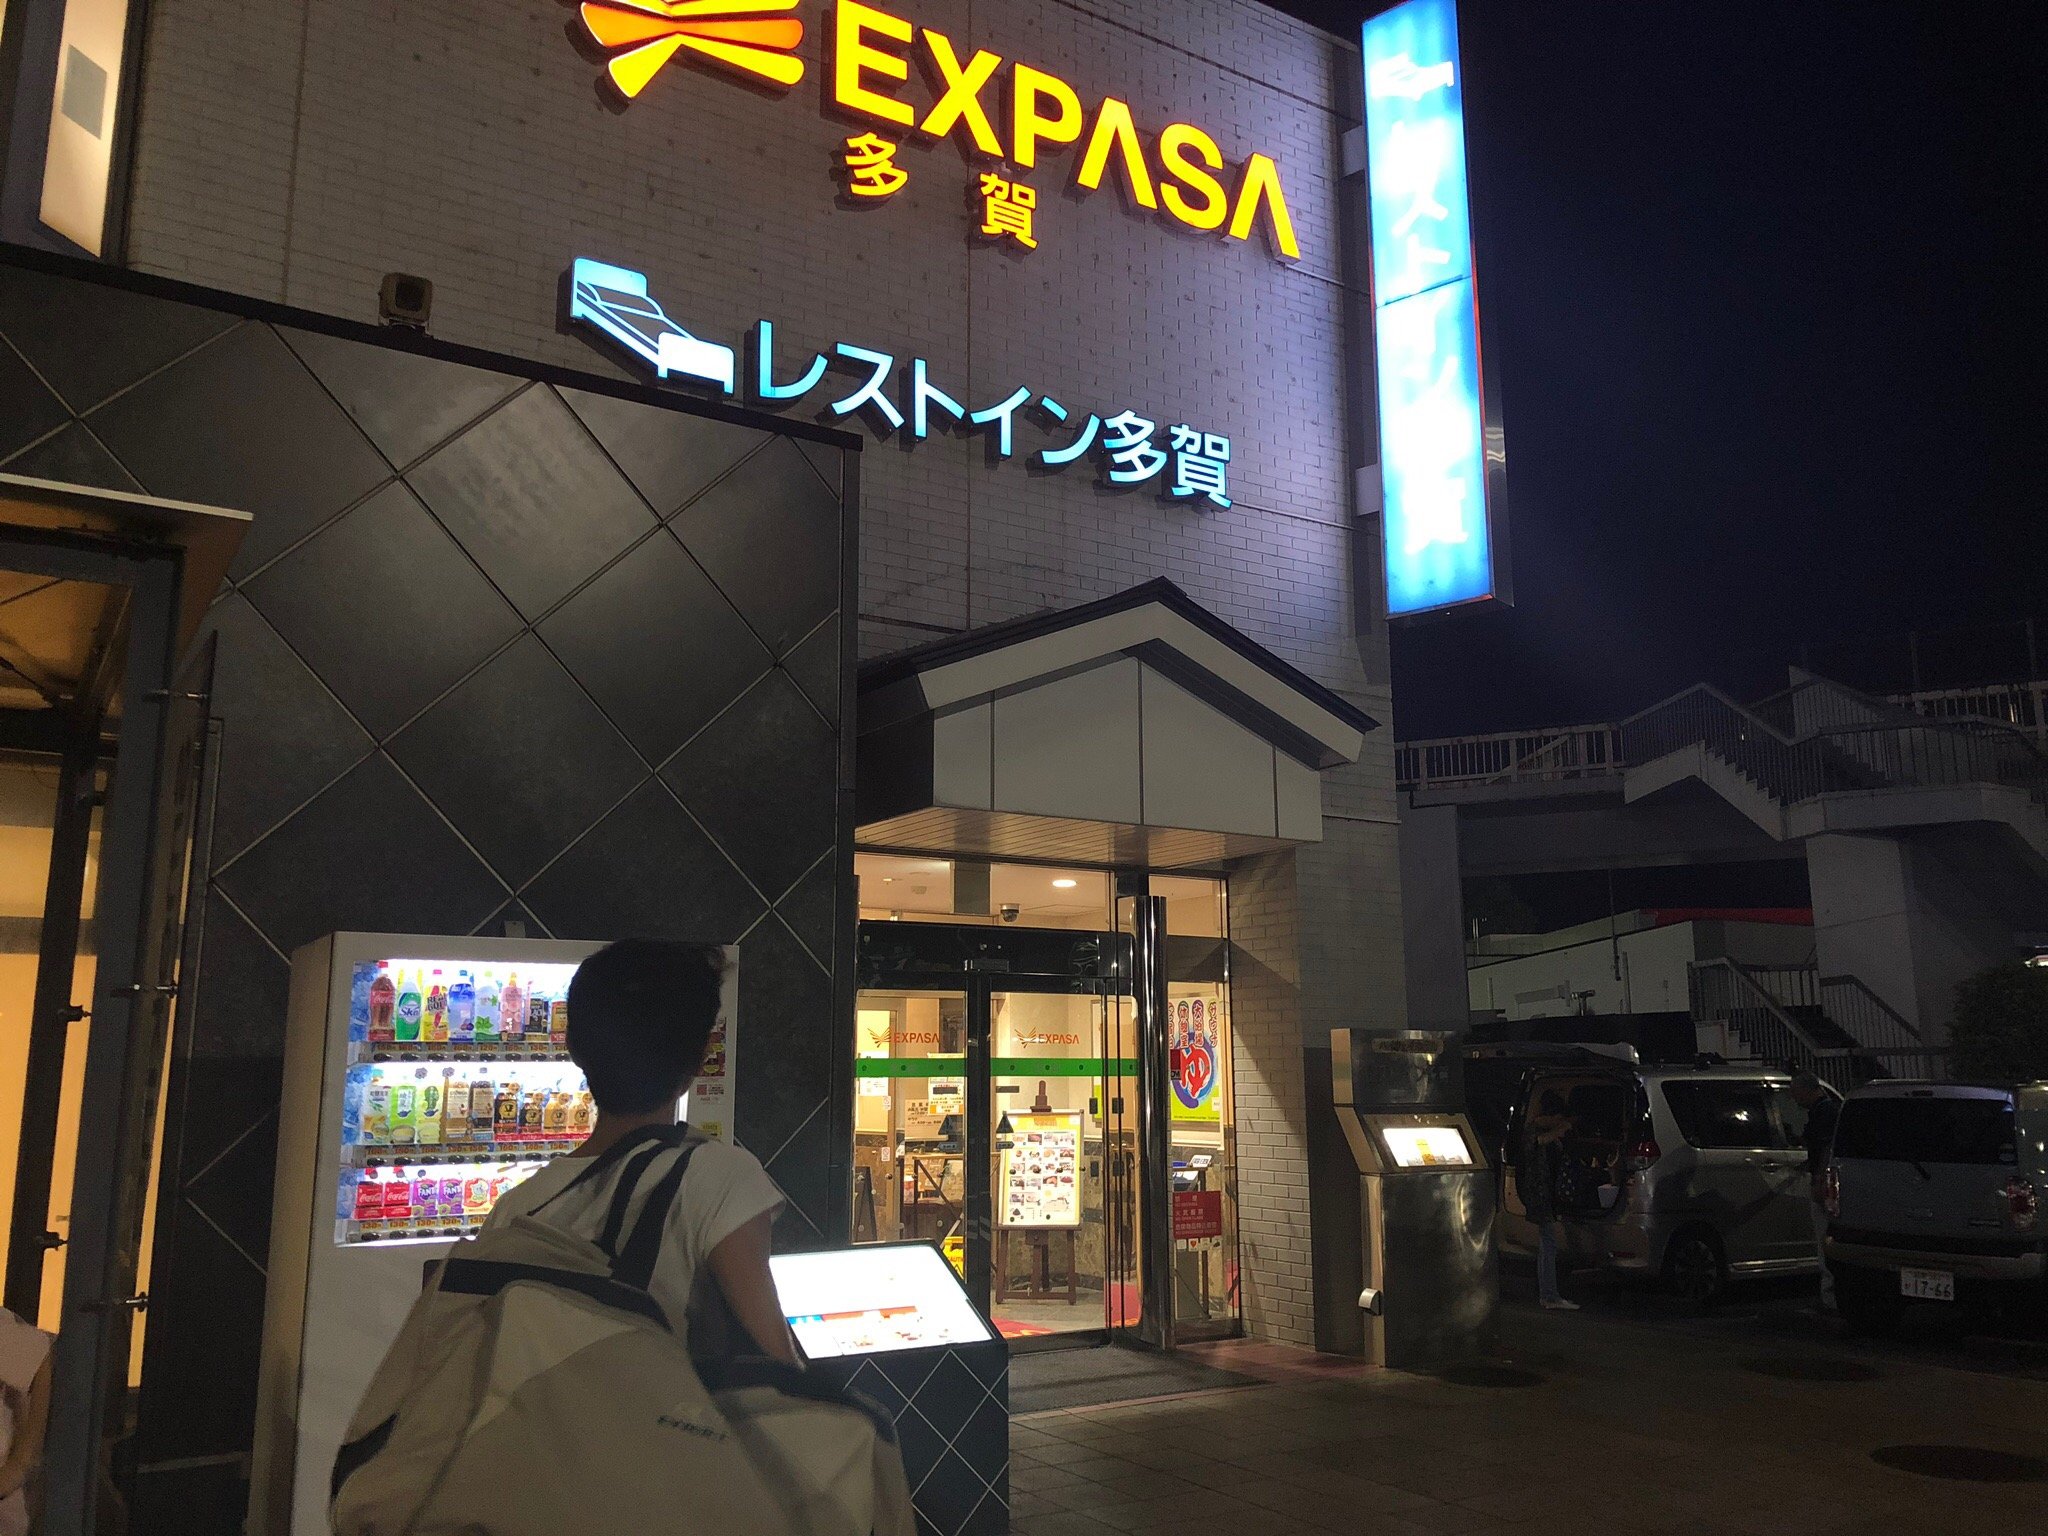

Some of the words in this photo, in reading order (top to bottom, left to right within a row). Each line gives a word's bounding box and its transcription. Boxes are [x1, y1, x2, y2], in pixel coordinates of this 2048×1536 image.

[836, 0, 1302, 260] EXPASA
[757, 319, 1232, 510] レストイン多賀
[893, 1032, 940, 1044] EXPASA
[1038, 1033, 1080, 1045] EXPASA
